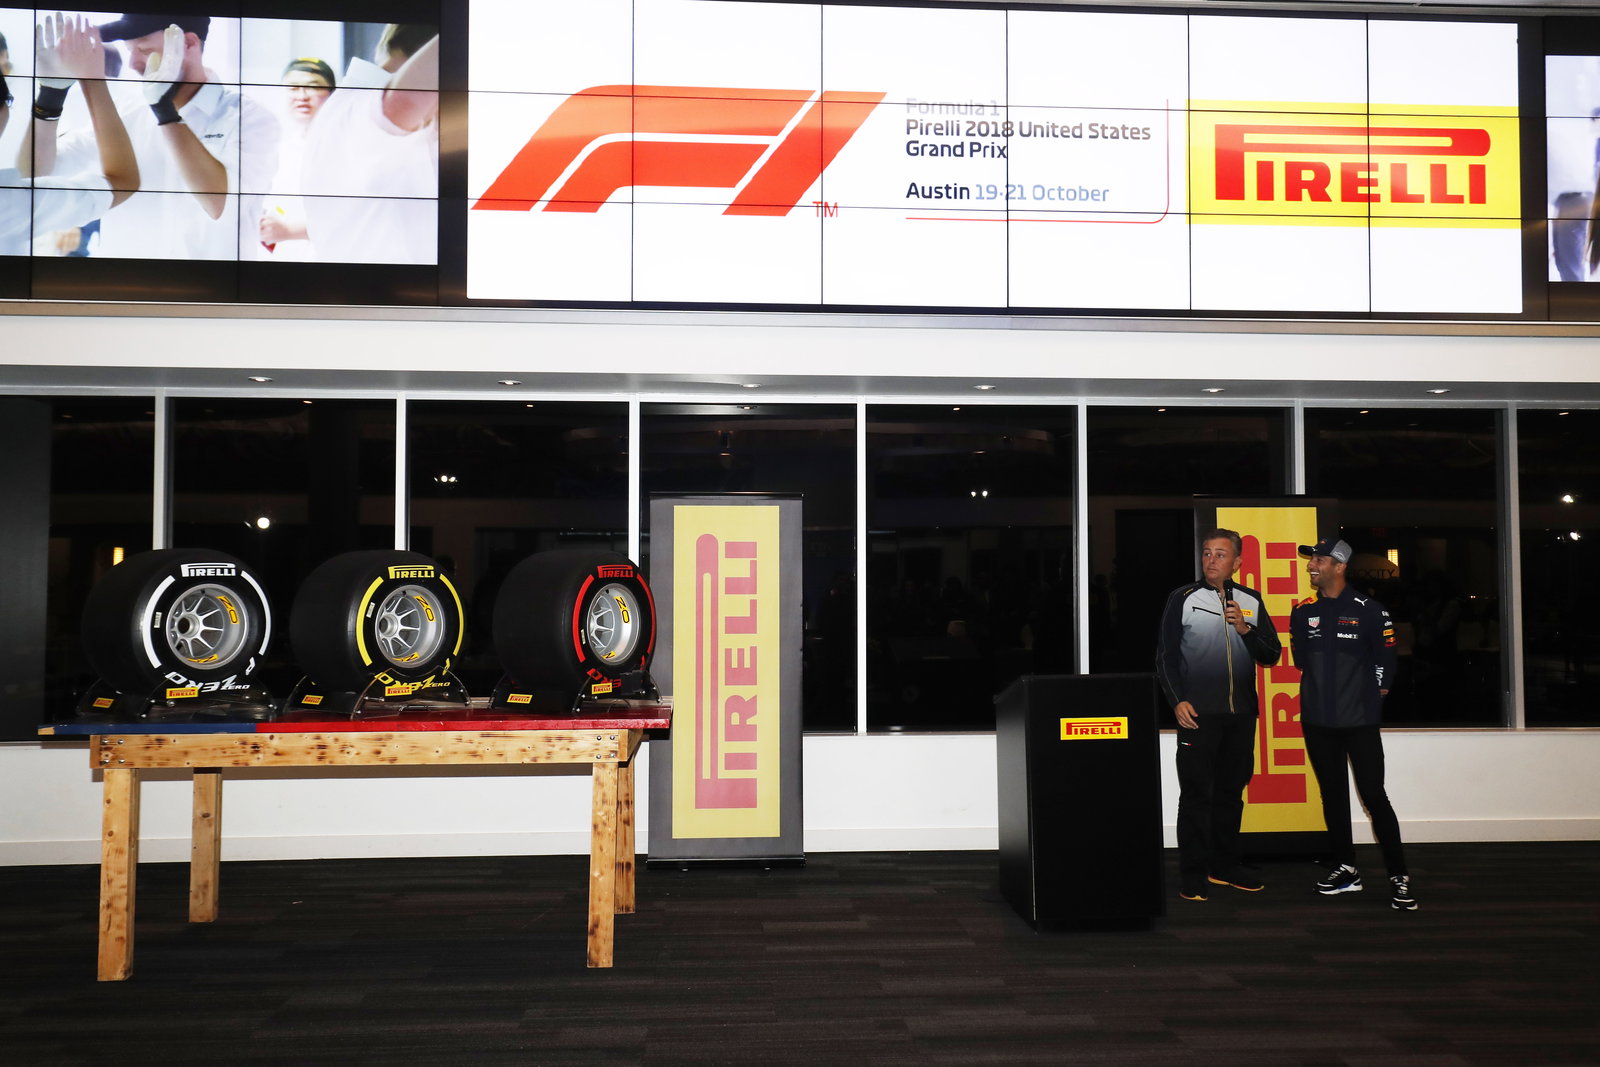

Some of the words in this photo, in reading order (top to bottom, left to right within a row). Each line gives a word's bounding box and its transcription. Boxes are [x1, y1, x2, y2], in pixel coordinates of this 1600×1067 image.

[906, 98, 985, 115] Formula
[906, 119, 960, 136] Pirelli
[966, 121, 1014, 137] 2018
[1019, 121, 1083, 138] United
[1089, 123, 1151, 140] States
[906, 140, 964, 157] Grand
[970, 142, 1008, 158] Prix
[1215, 124, 1491, 204] PIRELLI
[906, 183, 970, 199] Austin
[1032, 185, 1109, 201] October
[181, 562, 236, 577] PIRELLI
[388, 565, 435, 579] PIRELLI
[597, 564, 633, 578] PIRELLI
[695, 534, 758, 809] PIRELLI
[1066, 721, 1122, 735] PIRELLI
